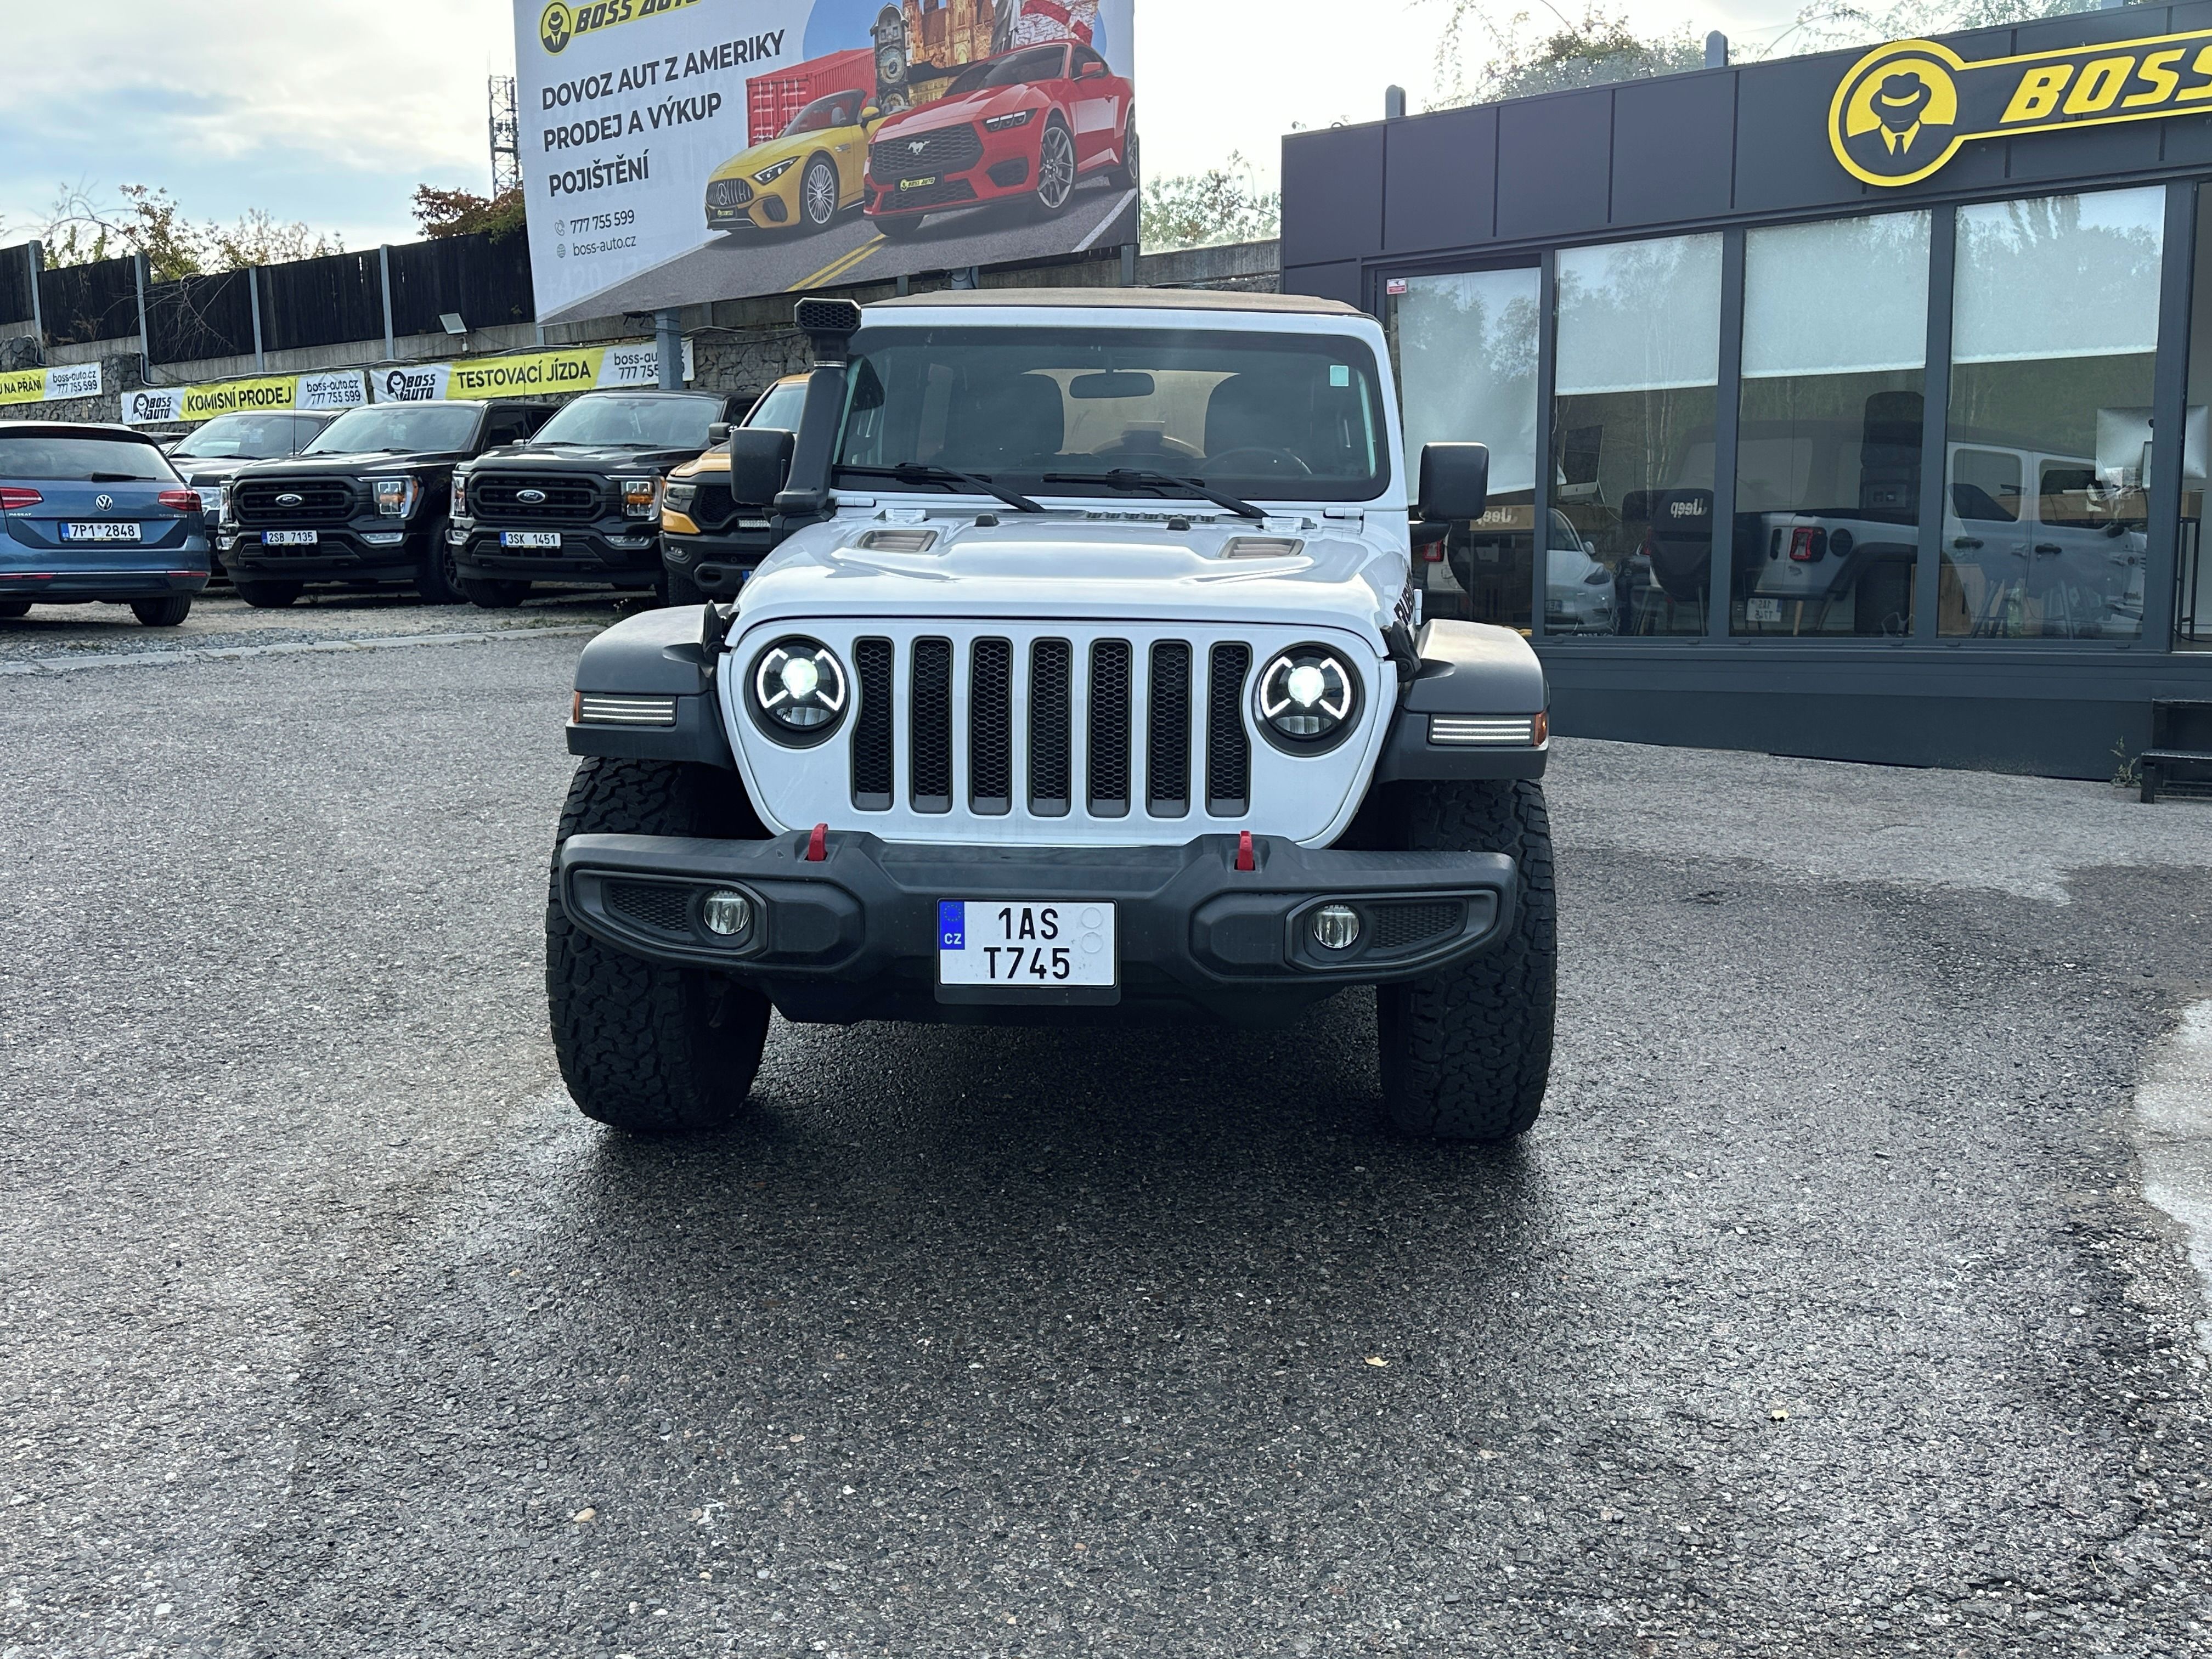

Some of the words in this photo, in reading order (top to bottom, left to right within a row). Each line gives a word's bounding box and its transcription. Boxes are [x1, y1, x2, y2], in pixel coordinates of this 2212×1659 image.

[574, 0, 632, 33] BOSS
[542, 72, 613, 110] DOVOZ
[618, 60, 659, 93] AUT
[665, 56, 679, 82] Z
[684, 29, 785, 77] AMERIKY
[544, 114, 622, 152] PRODEJ
[628, 110, 644, 134] A
[647, 92, 721, 129] VÝKUP
[549, 149, 650, 196] POJIŠTĚNÍ
[571, 218, 590, 234] 777
[592, 213, 612, 230] 755
[614, 210, 635, 226] 599
[573, 236, 636, 256] boss-auto.cz
[53, 370, 96, 383] boss-auto.cz
[456, 359, 542, 389] TESTOVACÍ
[546, 358, 591, 381] JÍZDA
[619, 366, 637, 380] 777
[4, 383, 16, 394] NA
[18, 376, 42, 392] PŘÁNÍ
[57, 383, 68, 394] 777
[70, 382, 82, 392] 755
[83, 380, 97, 390] 599
[307, 380, 358, 392] boss-auto.cz
[406, 374, 436, 388] BOSS
[188, 386, 236, 411] KOMISNÍ
[239, 386, 291, 407] PRODEJ
[312, 393, 325, 404] 777
[329, 391, 343, 403] 755
[345, 390, 360, 402] 599
[403, 387, 433, 400] AUTO
[149, 397, 171, 408] BOSS
[145, 408, 171, 420] AUTO
[71, 525, 95, 537] 7P1
[104, 525, 135, 537] 2848
[269, 533, 285, 543] 2SB
[291, 532, 313, 542] 7135
[508, 534, 525, 544] 3SK
[533, 534, 556, 545] 1451
[998, 907, 1058, 939] 1AS
[944, 933, 962, 944] CZ
[984, 947, 1070, 979] T745
